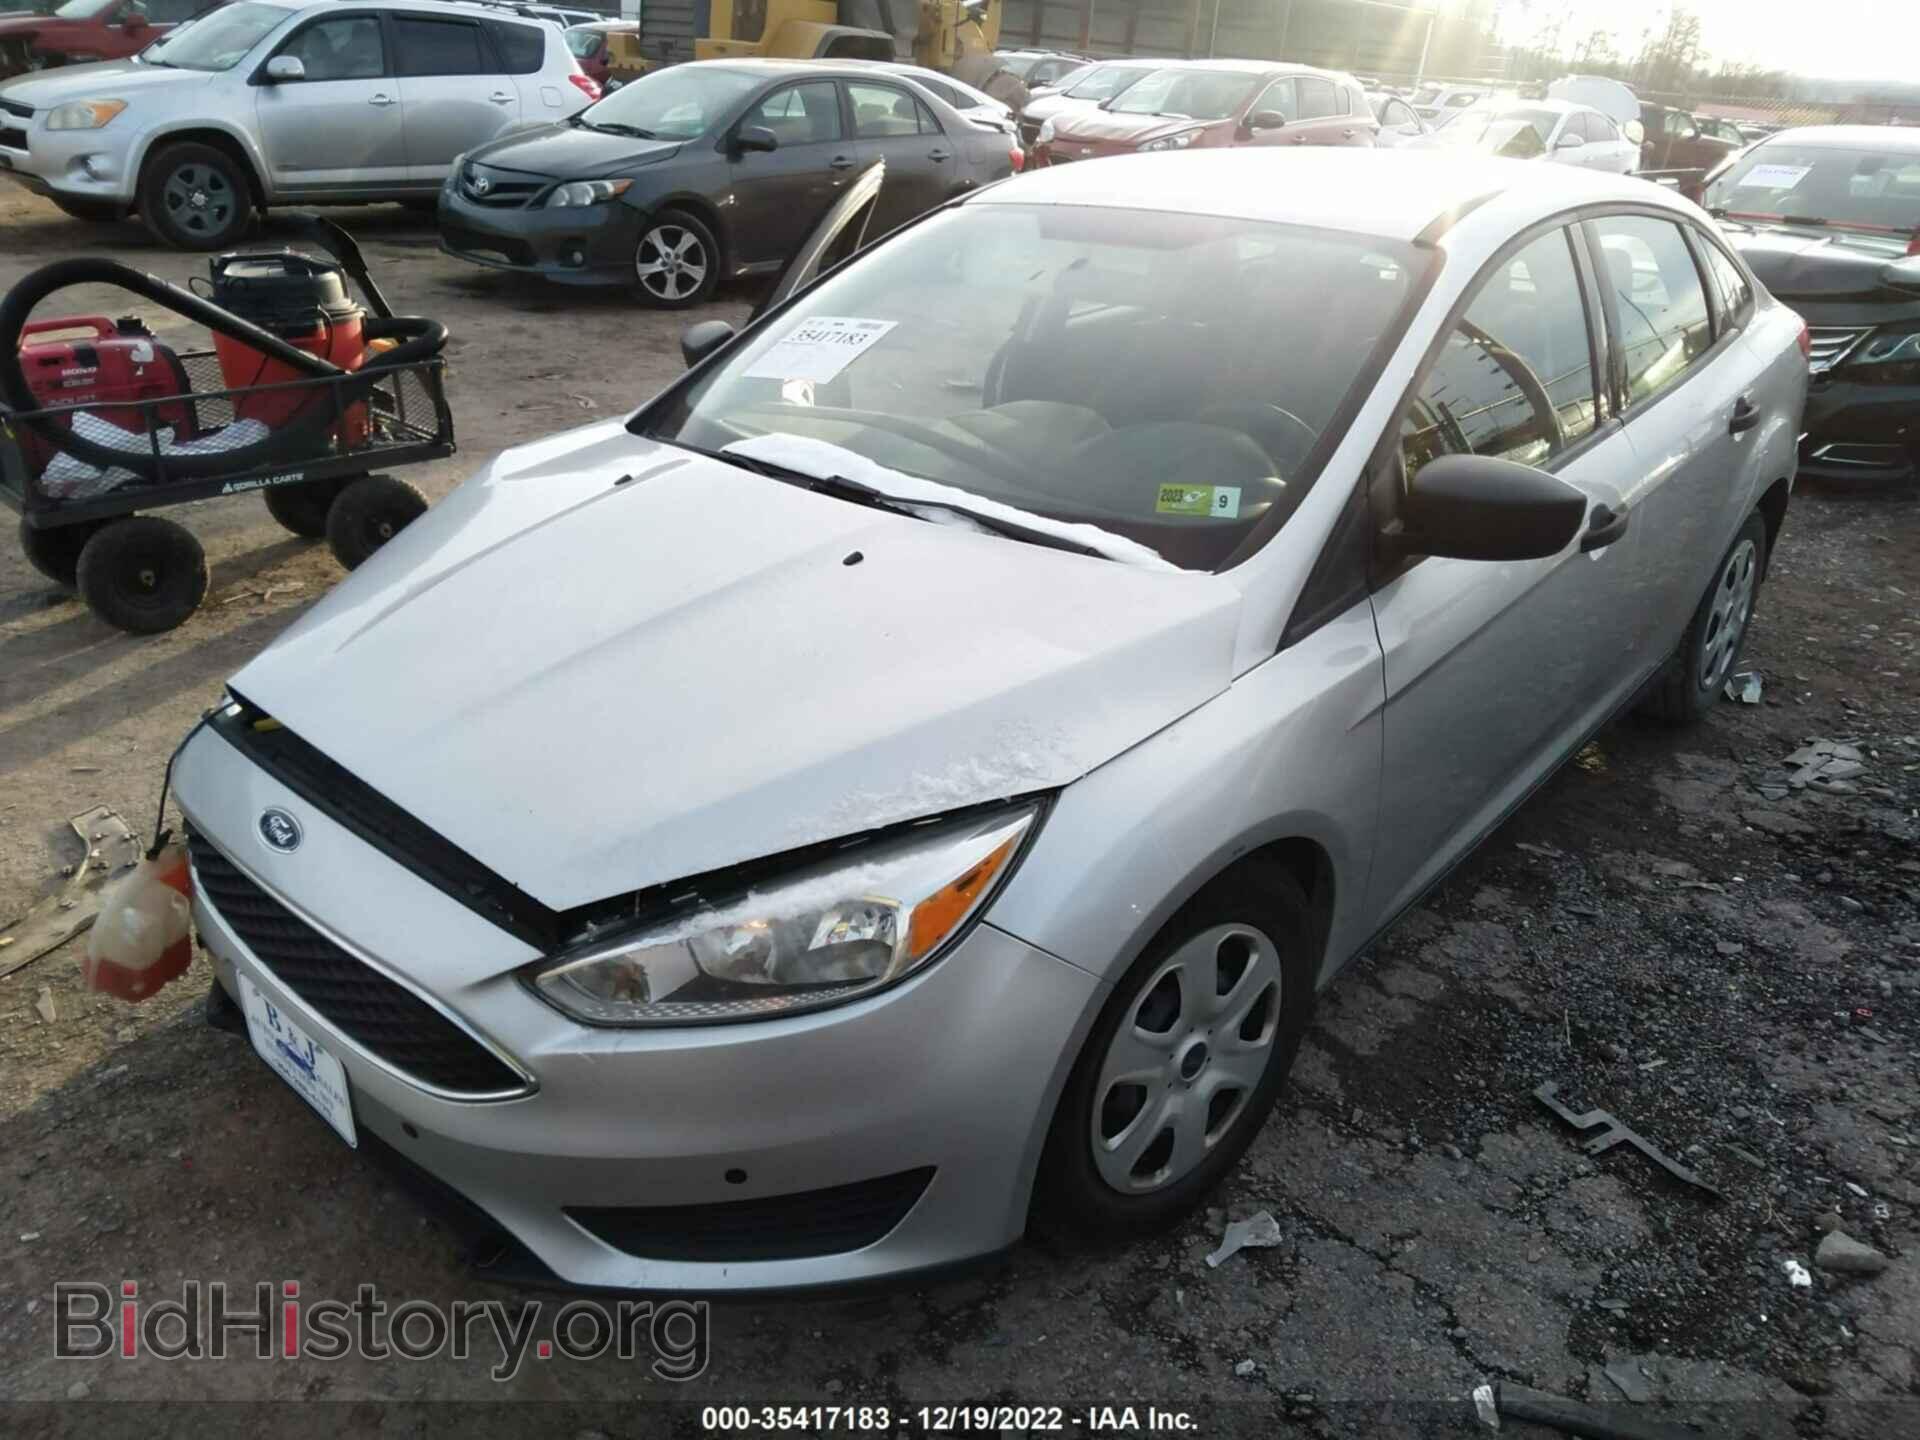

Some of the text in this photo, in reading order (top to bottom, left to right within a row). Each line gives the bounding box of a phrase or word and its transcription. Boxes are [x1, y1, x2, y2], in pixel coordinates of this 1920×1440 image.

[791, 329, 869, 345] 35417183
[1218, 494, 1229, 509] 9
[268, 815, 294, 846] Ford
